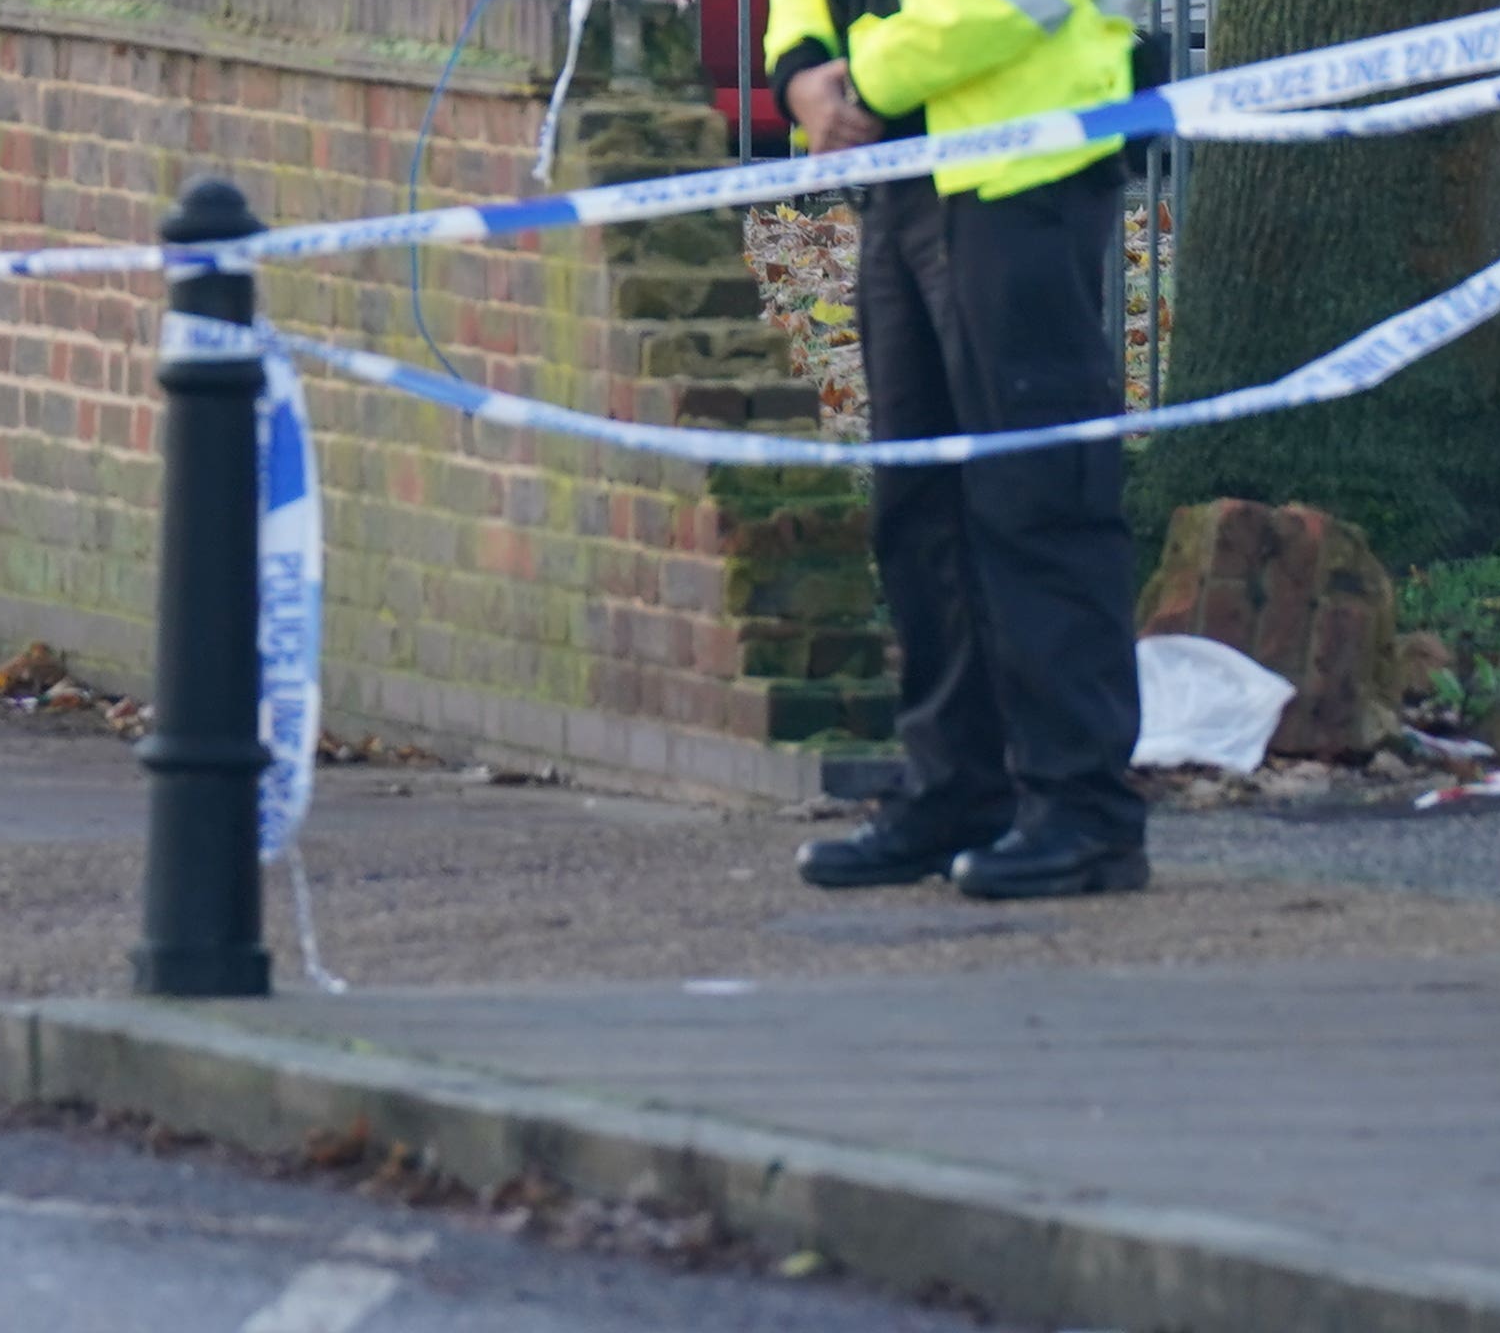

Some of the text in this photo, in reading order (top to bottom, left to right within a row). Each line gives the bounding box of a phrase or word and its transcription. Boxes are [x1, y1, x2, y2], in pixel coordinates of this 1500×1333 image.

[1208, 67, 1317, 114] POLICE
[1324, 52, 1396, 92] LINE
[1403, 38, 1450, 76] DO
